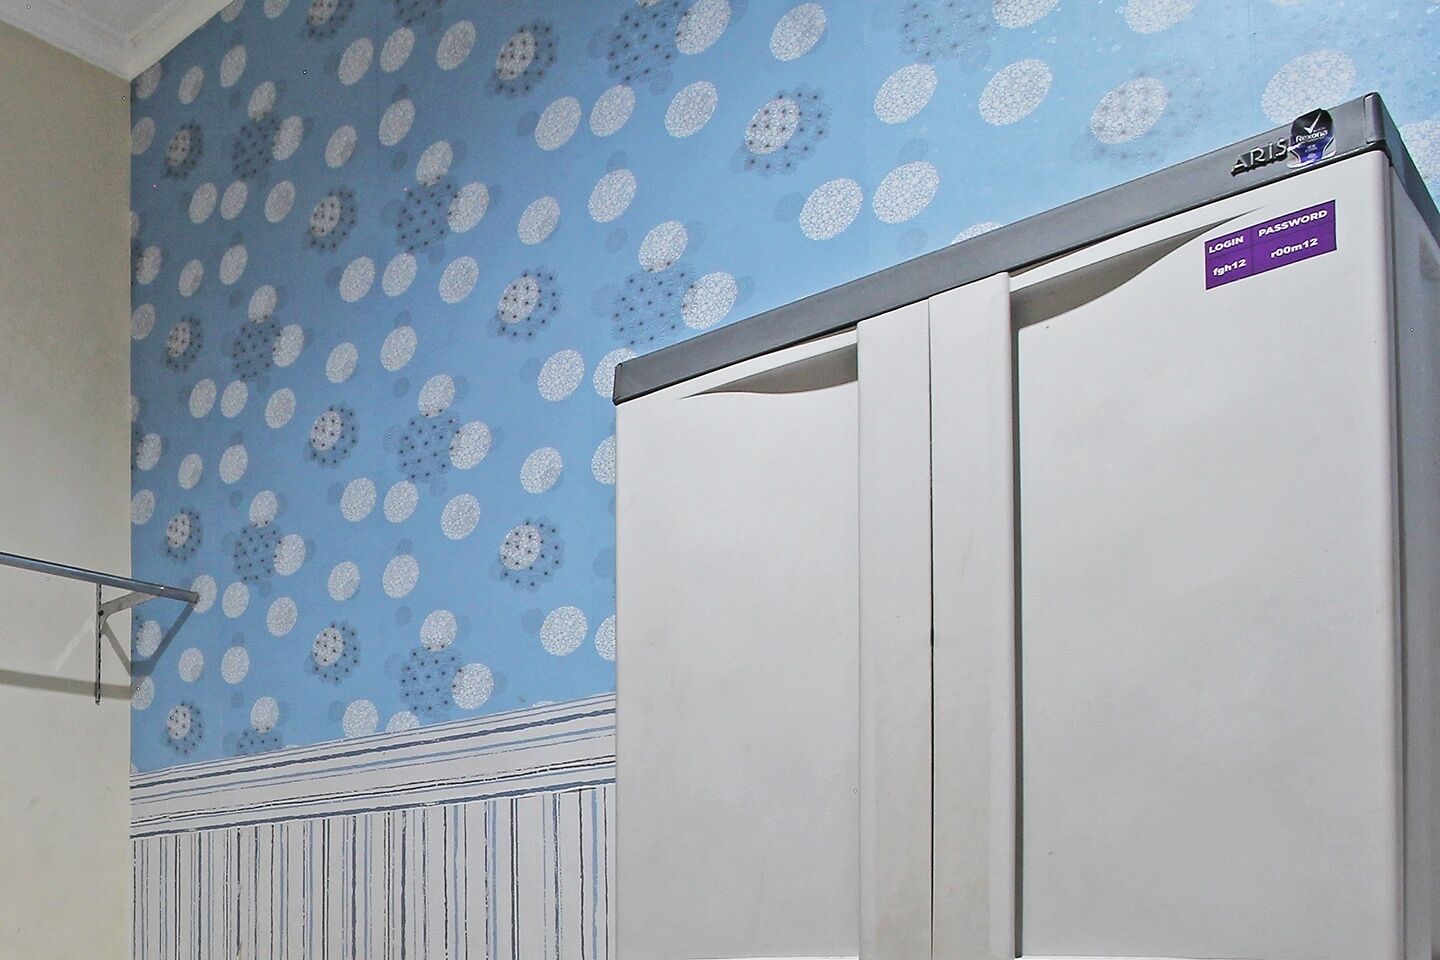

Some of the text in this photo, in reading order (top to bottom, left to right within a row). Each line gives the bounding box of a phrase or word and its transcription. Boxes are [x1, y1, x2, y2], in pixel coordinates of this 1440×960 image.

[1295, 129, 1328, 143] Rexona
[1208, 210, 1328, 253] LOGIN PASSWORD
[1212, 238, 1319, 276] fgh12 r00m12
